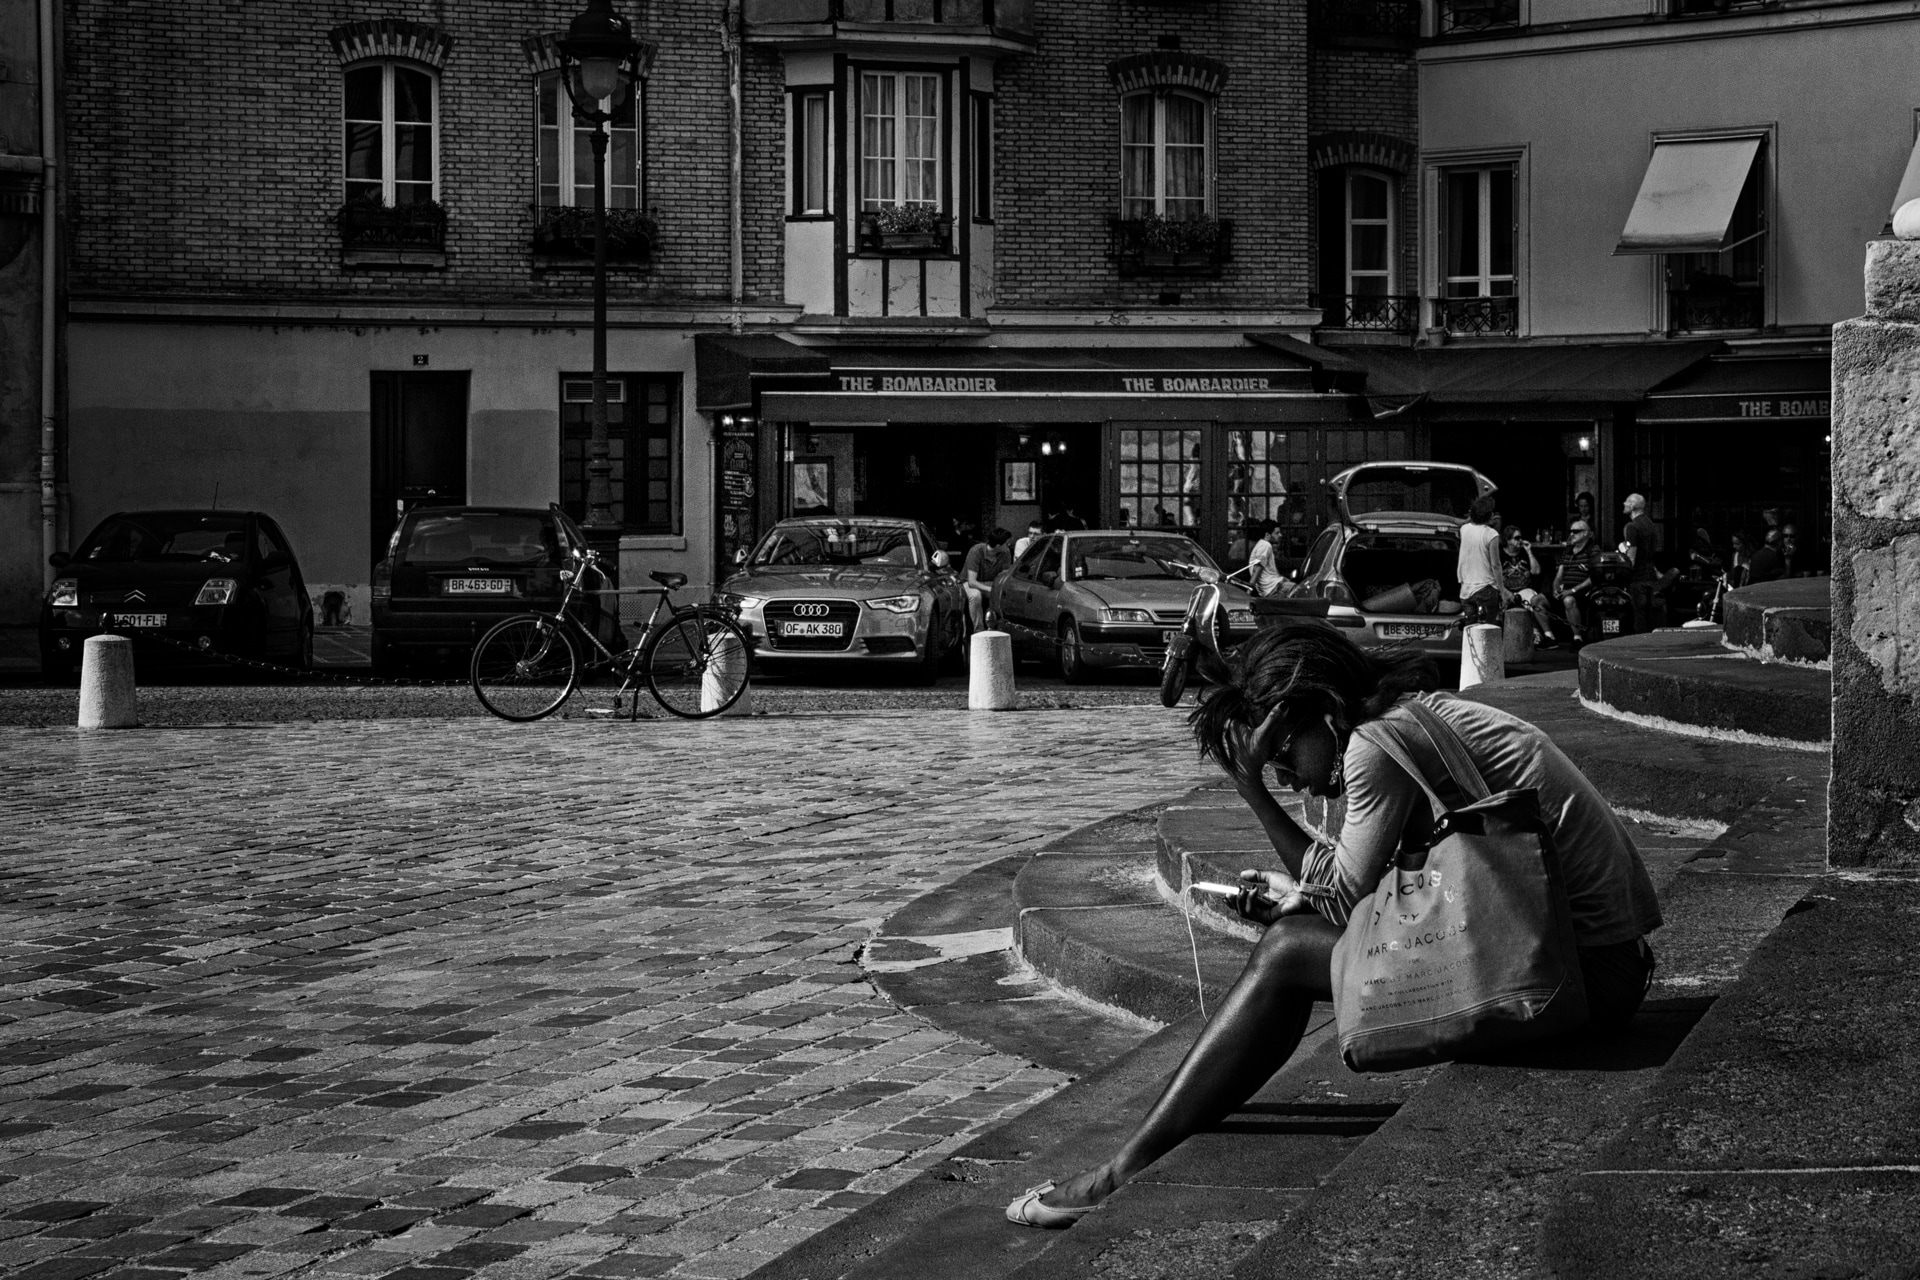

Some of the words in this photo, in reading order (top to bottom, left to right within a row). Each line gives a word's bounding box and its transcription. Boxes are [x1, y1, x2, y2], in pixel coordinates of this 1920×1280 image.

[417, 355, 424, 364] 2
[839, 376, 874, 391] THE
[882, 376, 997, 392] BOMBARDIER
[1122, 377, 1155, 392] THE
[1162, 377, 1270, 392] BOMBARDIER
[1739, 401, 1772, 417] THE
[785, 623, 799, 634] OF
[806, 623, 820, 634] AK
[822, 624, 841, 635] 380
[1366, 941, 1399, 959] MARC
[1404, 921, 1468, 949] JACOBS
[1406, 969, 1433, 980] MARC
[1437, 956, 1475, 974] JACOBS
